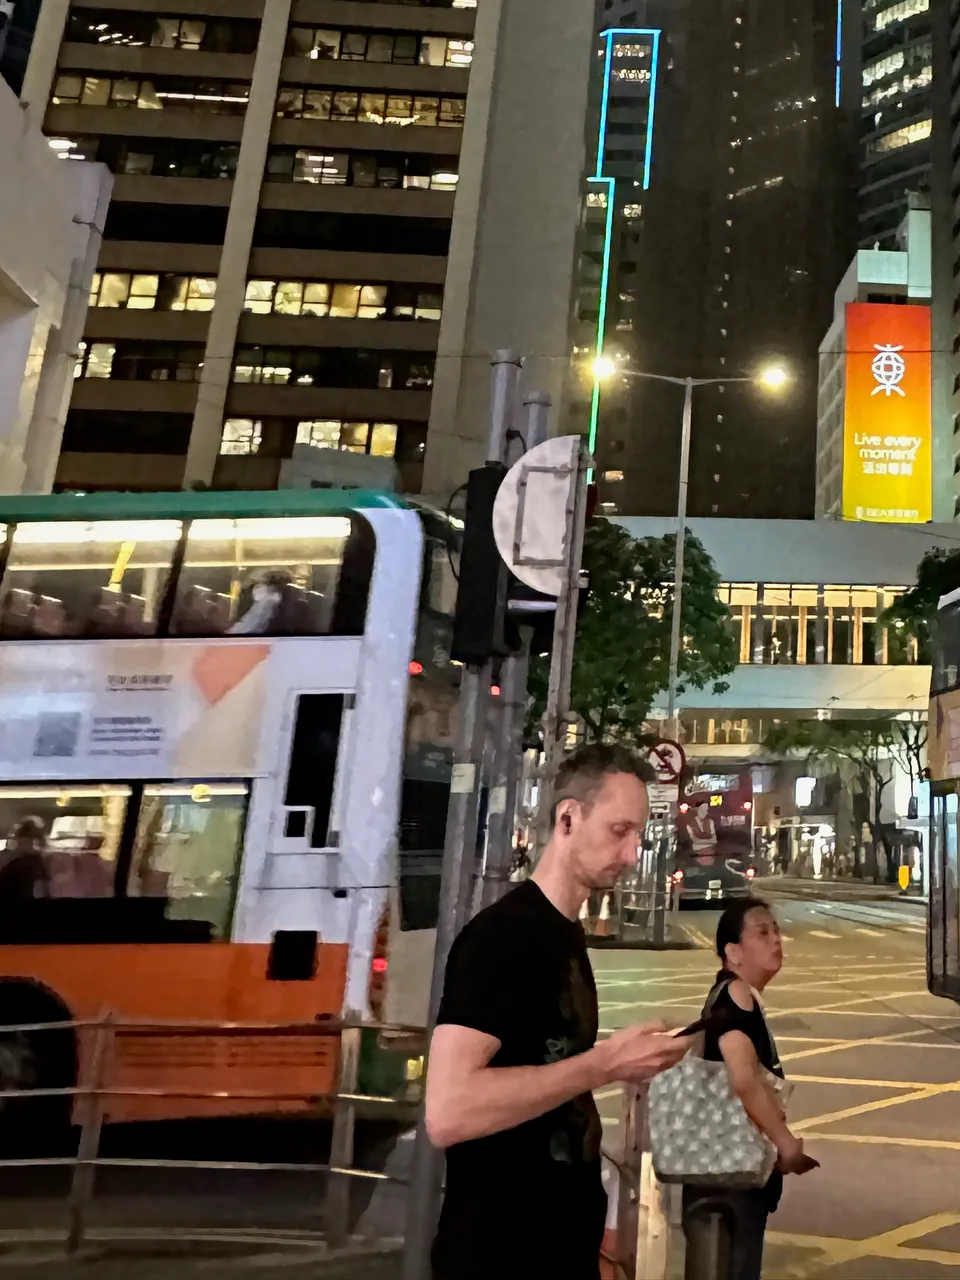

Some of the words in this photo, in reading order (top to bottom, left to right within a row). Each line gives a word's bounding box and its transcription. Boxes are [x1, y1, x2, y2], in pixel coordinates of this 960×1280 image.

[854, 432, 882, 446] Live
[883, 435, 922, 449] every
[859, 448, 917, 461] moment
